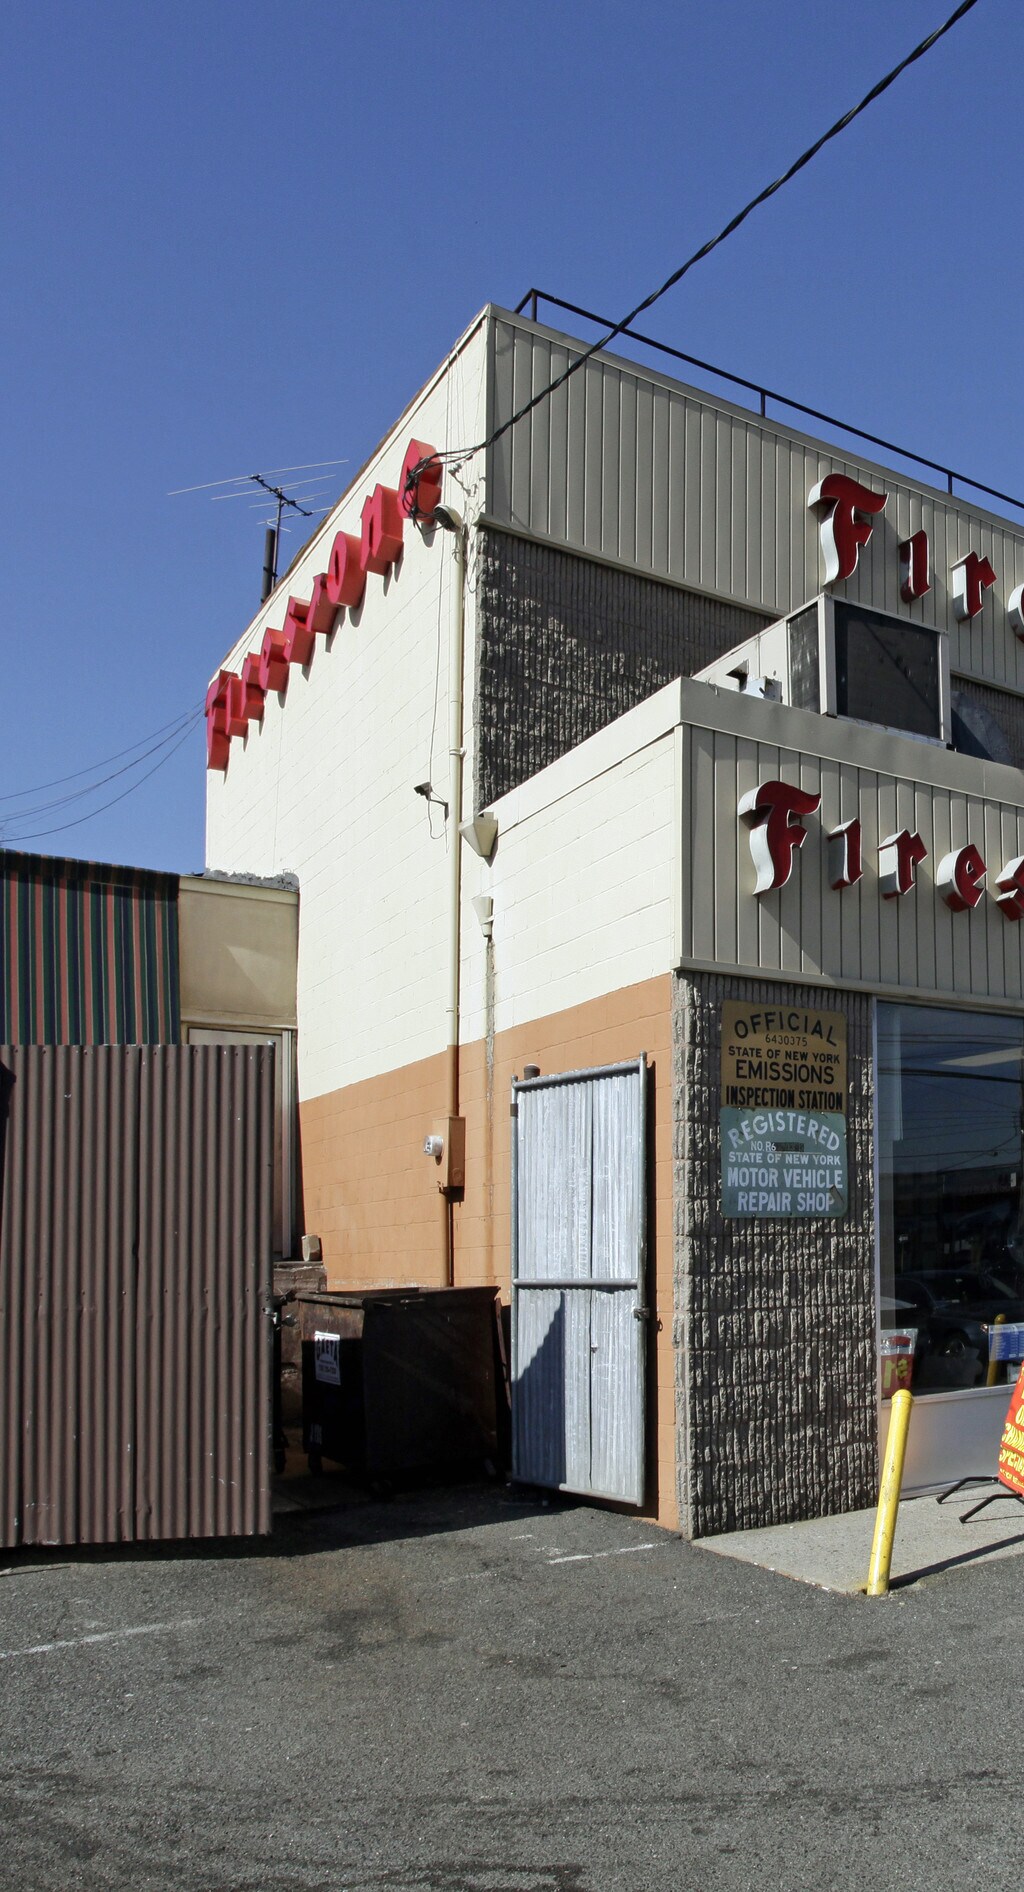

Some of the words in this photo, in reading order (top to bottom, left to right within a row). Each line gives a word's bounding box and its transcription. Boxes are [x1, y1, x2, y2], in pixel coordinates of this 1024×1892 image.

[734, 1011, 837, 1047] OFFICIAL
[765, 1033, 808, 1047] 6430375
[728, 1045, 762, 1058] STATE
[767, 1048, 781, 1059] OF
[785, 1050, 808, 1061] NEW
[812, 1052, 840, 1064] YORK
[736, 1059, 834, 1084] EMISSIONS
[726, 1085, 795, 1108] INSPECTION
[798, 1089, 843, 1110] STATION
[728, 1111, 840, 1151] REGISTERED
[728, 1151, 763, 1163] STATE
[767, 1153, 781, 1163] OF
[785, 1154, 809, 1165] NEW
[812, 1155, 841, 1165] YORK
[727, 1167, 779, 1188] MOTOR
[783, 1168, 843, 1189] VEHICLE
[737, 1191, 791, 1212] REPAIR
[797, 1192, 835, 1212] SHOP
